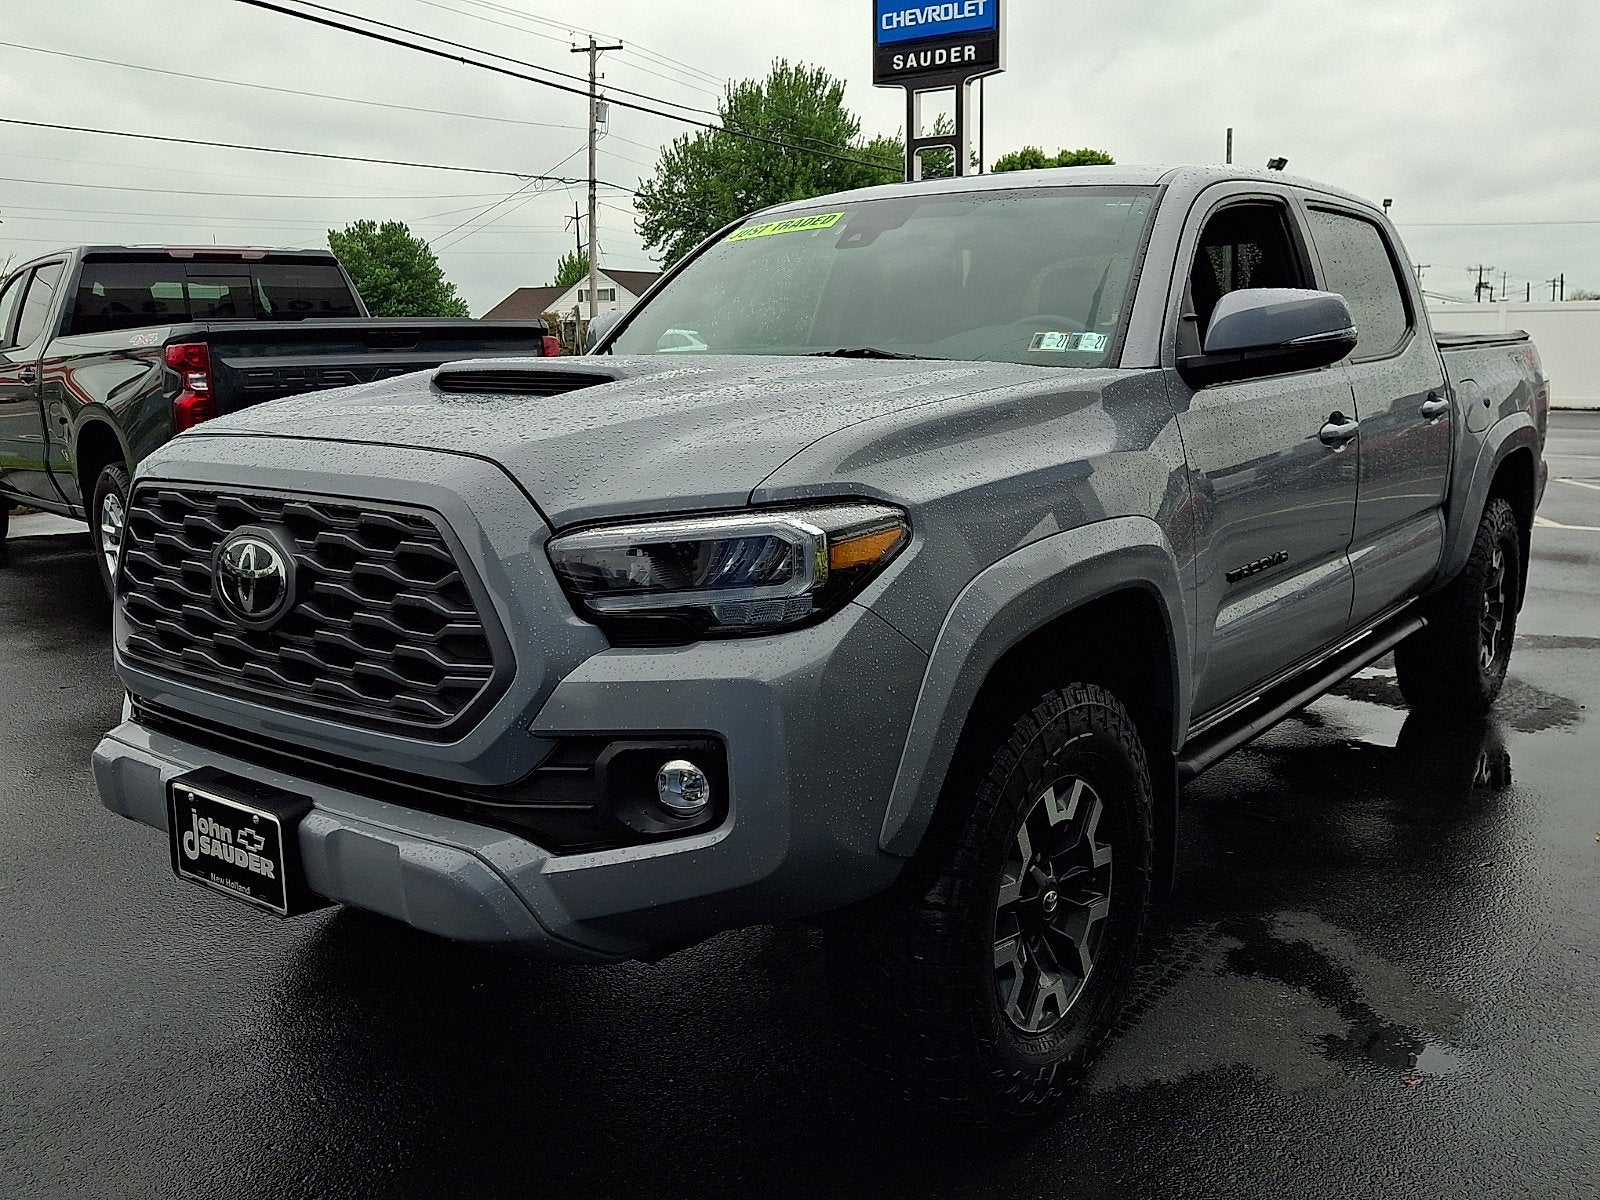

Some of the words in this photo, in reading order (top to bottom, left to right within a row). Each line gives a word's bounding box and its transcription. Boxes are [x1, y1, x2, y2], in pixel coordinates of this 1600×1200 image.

[882, 0, 988, 30] CHEVROLET
[892, 45, 976, 70] SAUDER
[729, 223, 774, 240] JUST
[771, 214, 838, 232] TRADED
[200, 835, 276, 880] SAUDER
[210, 872, 225, 885] New
[225, 878, 251, 896] Holland
